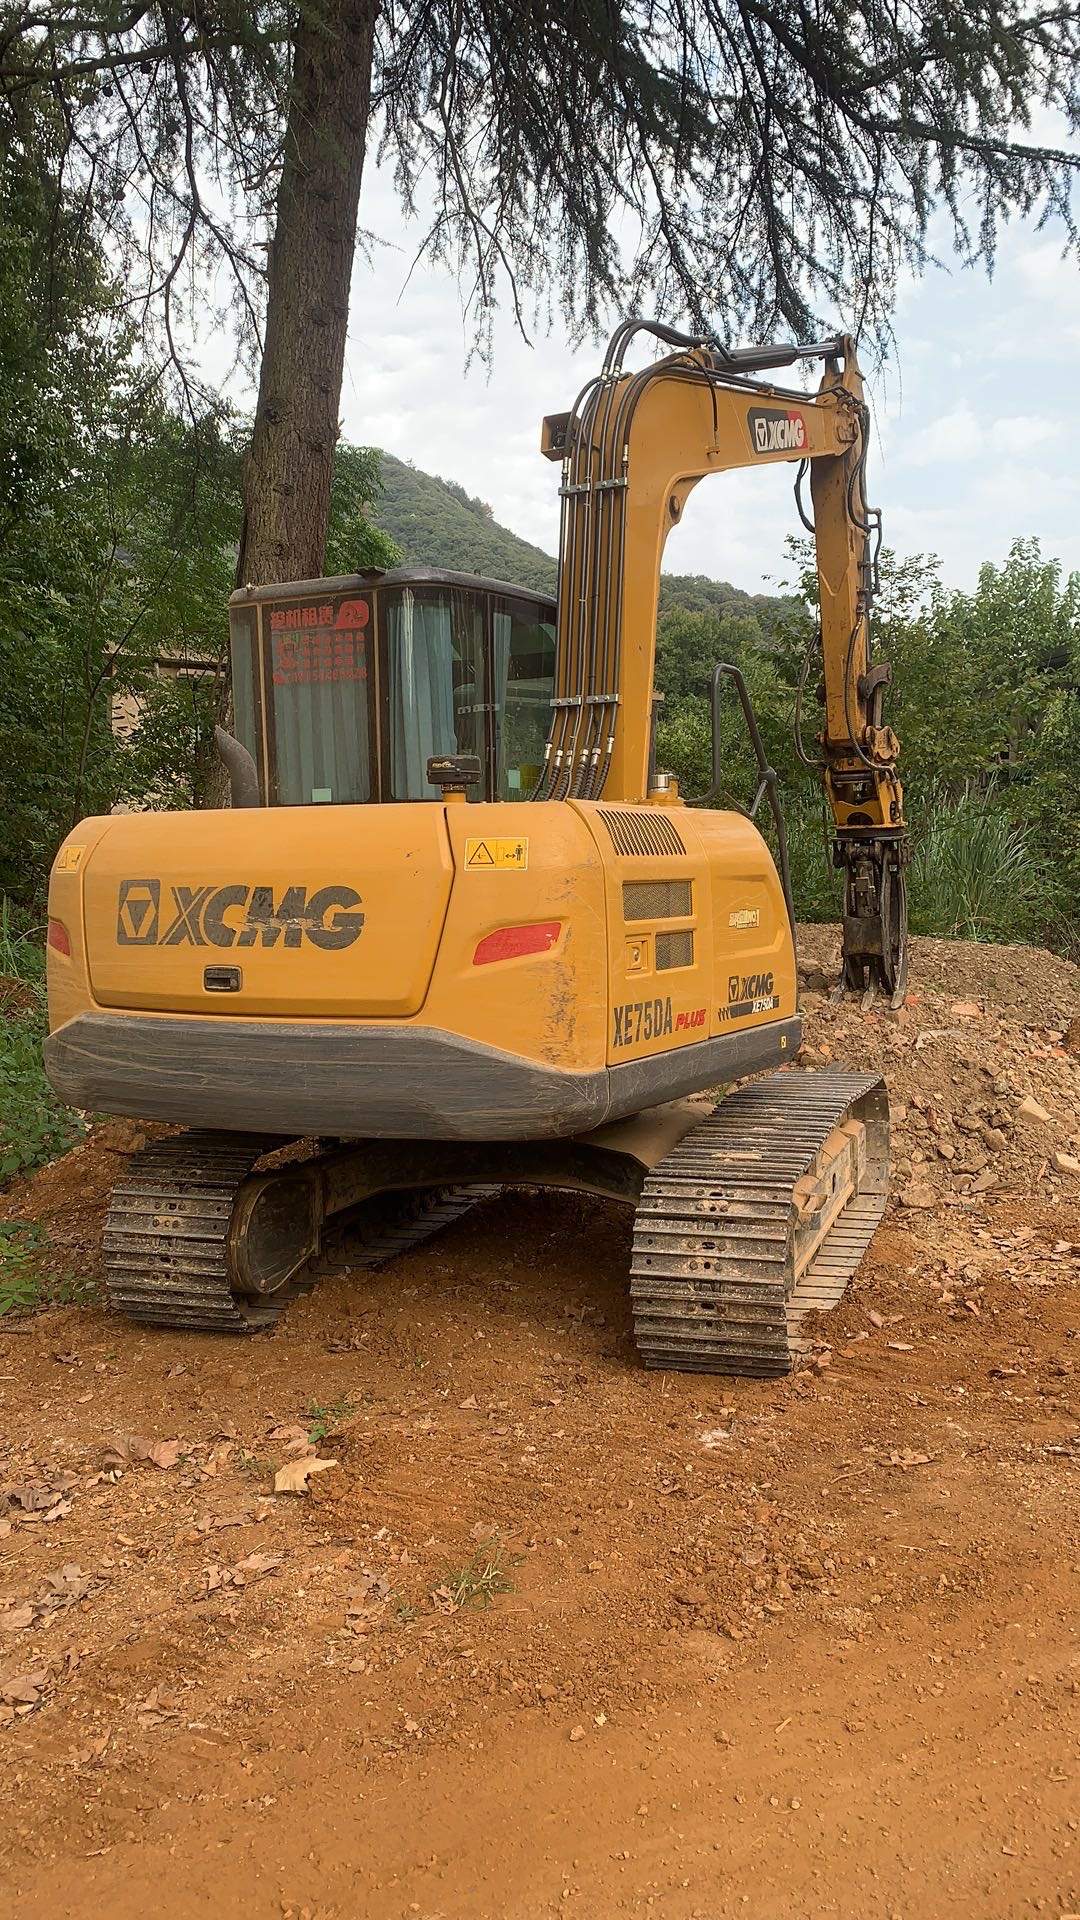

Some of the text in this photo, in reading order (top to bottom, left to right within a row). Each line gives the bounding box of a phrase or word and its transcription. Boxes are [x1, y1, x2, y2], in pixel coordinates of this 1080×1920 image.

[768, 418, 805, 450] XCMG
[158, 884, 365, 951] XCMG
[740, 972, 774, 1001] XCMG
[613, 996, 707, 1048] XE75DA PLUS
